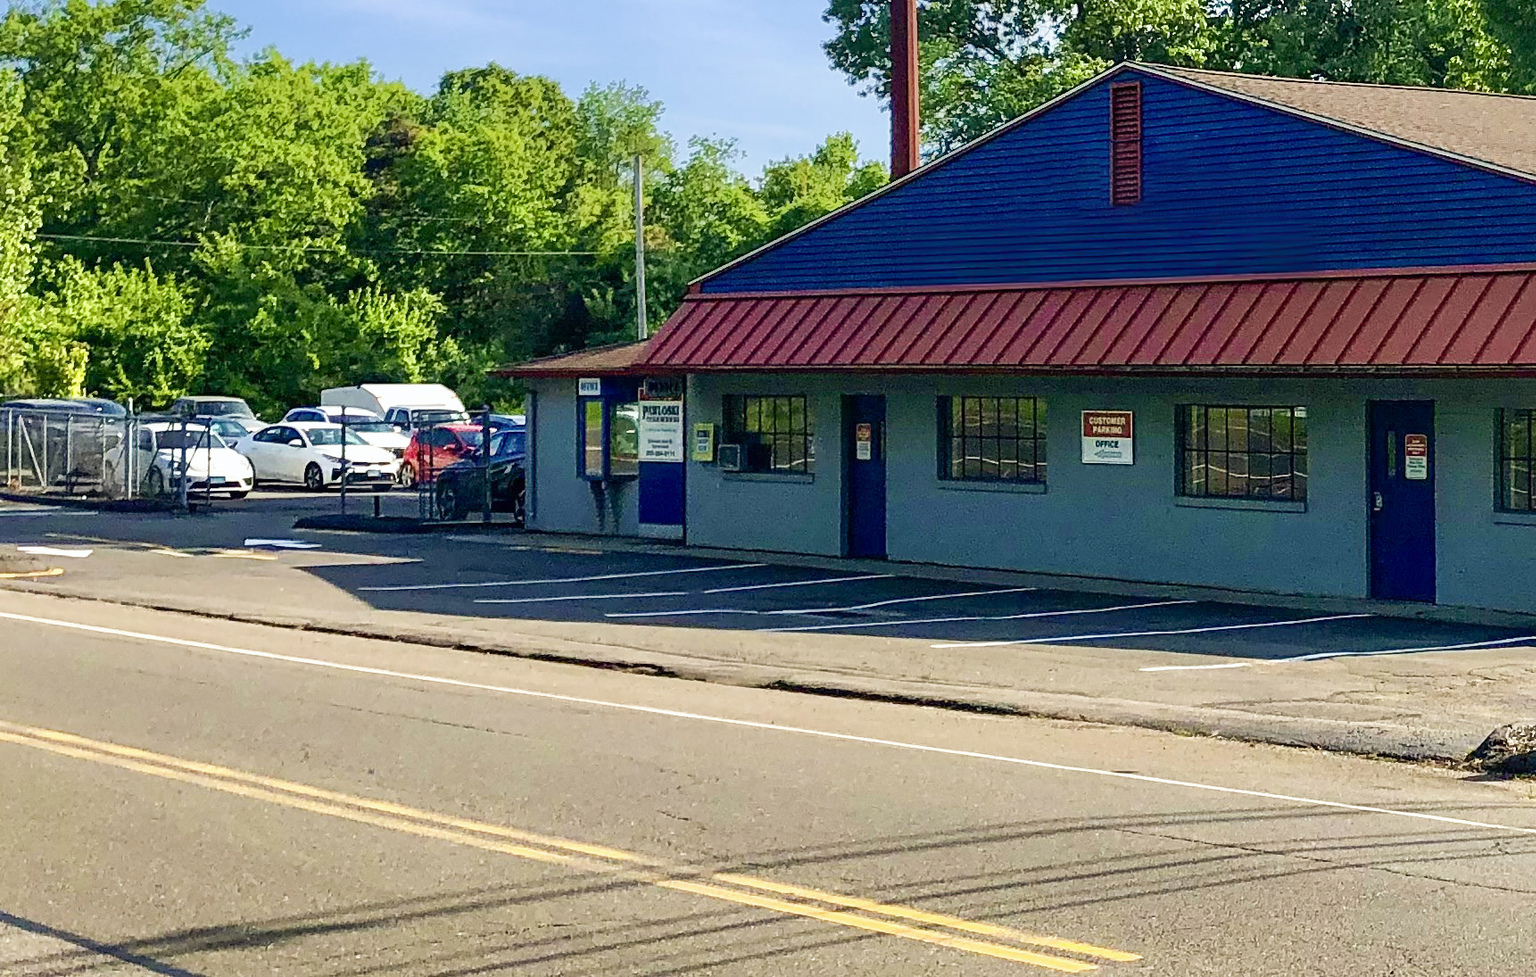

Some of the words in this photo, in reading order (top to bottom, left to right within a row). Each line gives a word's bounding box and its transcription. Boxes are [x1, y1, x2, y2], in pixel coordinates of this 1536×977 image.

[1088, 416, 1126, 425] CUSTOMER
[1092, 425, 1123, 434] PARKING
[1095, 440, 1120, 449] OFFICE
